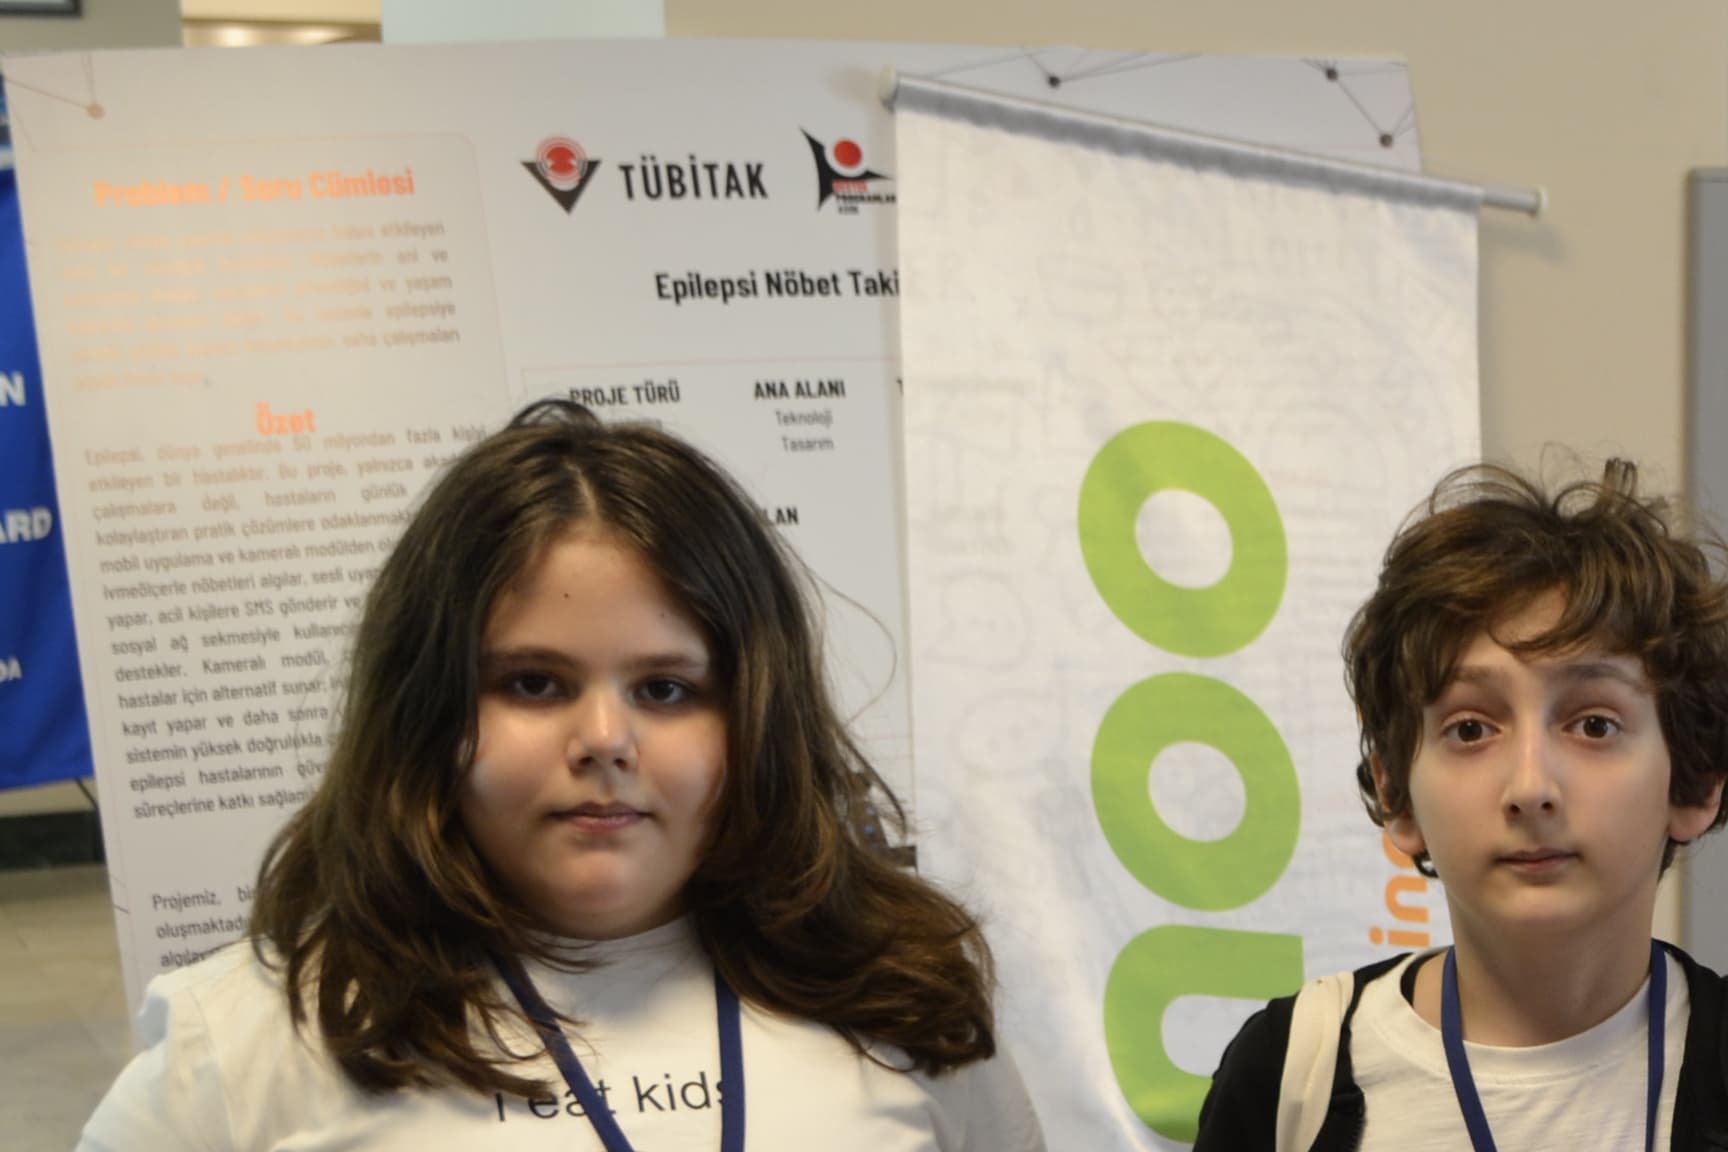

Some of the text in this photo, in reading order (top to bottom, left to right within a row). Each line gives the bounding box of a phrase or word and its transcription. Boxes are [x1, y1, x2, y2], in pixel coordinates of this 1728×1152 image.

[95, 167, 415, 208] Problem / Soru Cümlesi
[618, 154, 769, 200] TÜBİTAK
[655, 272, 758, 305] Epilepsi
[766, 270, 841, 298] Nöbet
[569, 380, 681, 407] PROJE TÜRÜ
[754, 380, 846, 401] ANA ALANI
[256, 402, 314, 435] Özet
[775, 409, 833, 428] Teknoloji
[781, 436, 834, 452] Tasarım
[100, 556, 139, 573] mobil
[144, 554, 213, 573] uygulama
[217, 551, 234, 564] ve
[305, 539, 374, 557] modülden
[192, 575, 256, 594] nöbetleri
[158, 606, 183, 624] acil
[188, 603, 239, 622] kişilere
[244, 599, 274, 617] SMS
[280, 596, 337, 618] gönderir
[112, 637, 157, 657] sosyal
[170, 634, 189, 654] ağ
[202, 654, 266, 674] Kameralı
[118, 691, 177, 709] hastalar
[182, 688, 208, 707] için
[212, 681, 276, 701] alternatif
[122, 707, 328, 739] kayıt yapar ve daha sonra
[126, 745, 187, 764] sistemin
[191, 740, 242, 761] yüksek
[130, 771, 185, 793] epilepsi
[199, 765, 284, 784] hastalarının
[134, 794, 255, 818] süreçlerine katkı
[528, 1080, 616, 1119] eat
